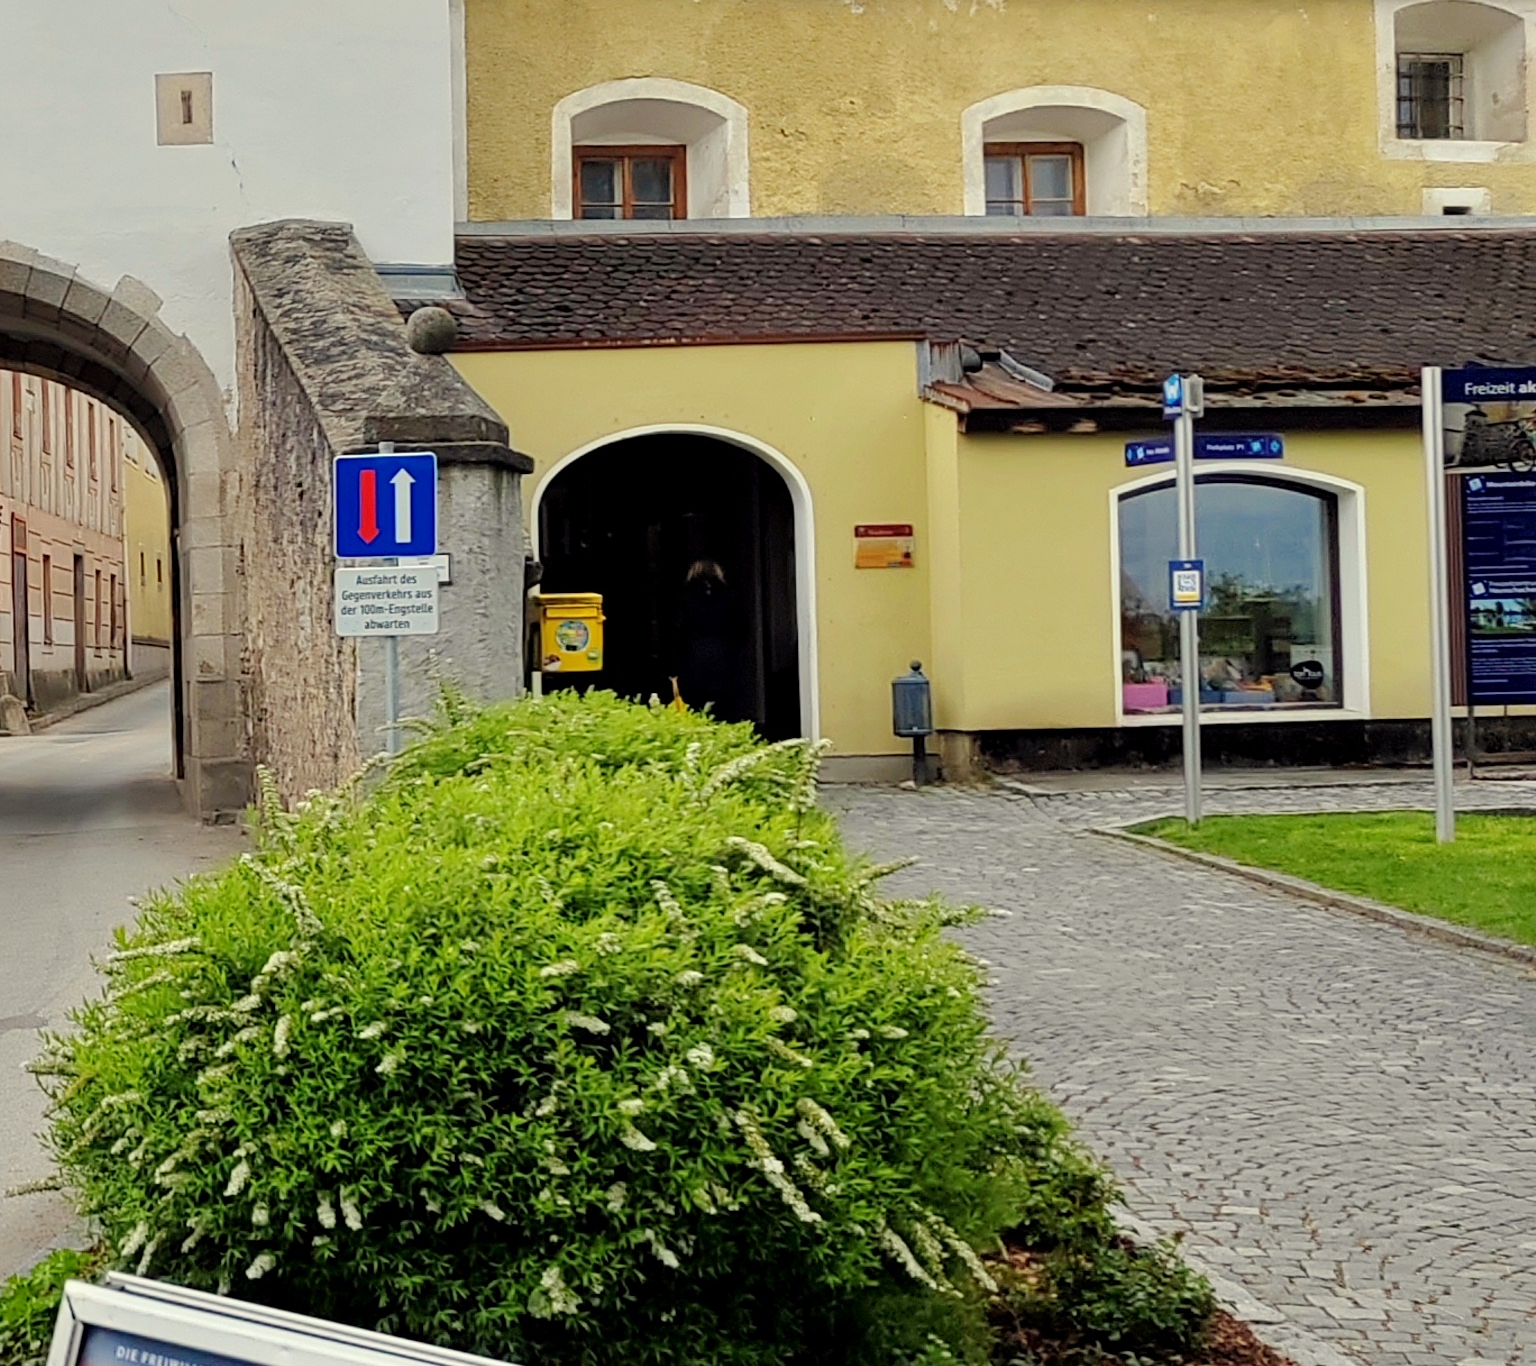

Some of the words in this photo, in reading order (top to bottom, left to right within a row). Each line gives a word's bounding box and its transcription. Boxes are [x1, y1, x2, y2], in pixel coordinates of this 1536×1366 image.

[1464, 382, 1516, 396] Freizeit
[356, 575, 397, 585] Ausfahrt
[400, 575, 417, 584] des
[341, 589, 413, 602] Gegenverkehrs
[415, 590, 433, 599] aus
[341, 606, 357, 615] der
[360, 603, 434, 616] 100m-Engstelle
[364, 620, 410, 630] abwarten
[116, 1345, 138, 1363] DIE
